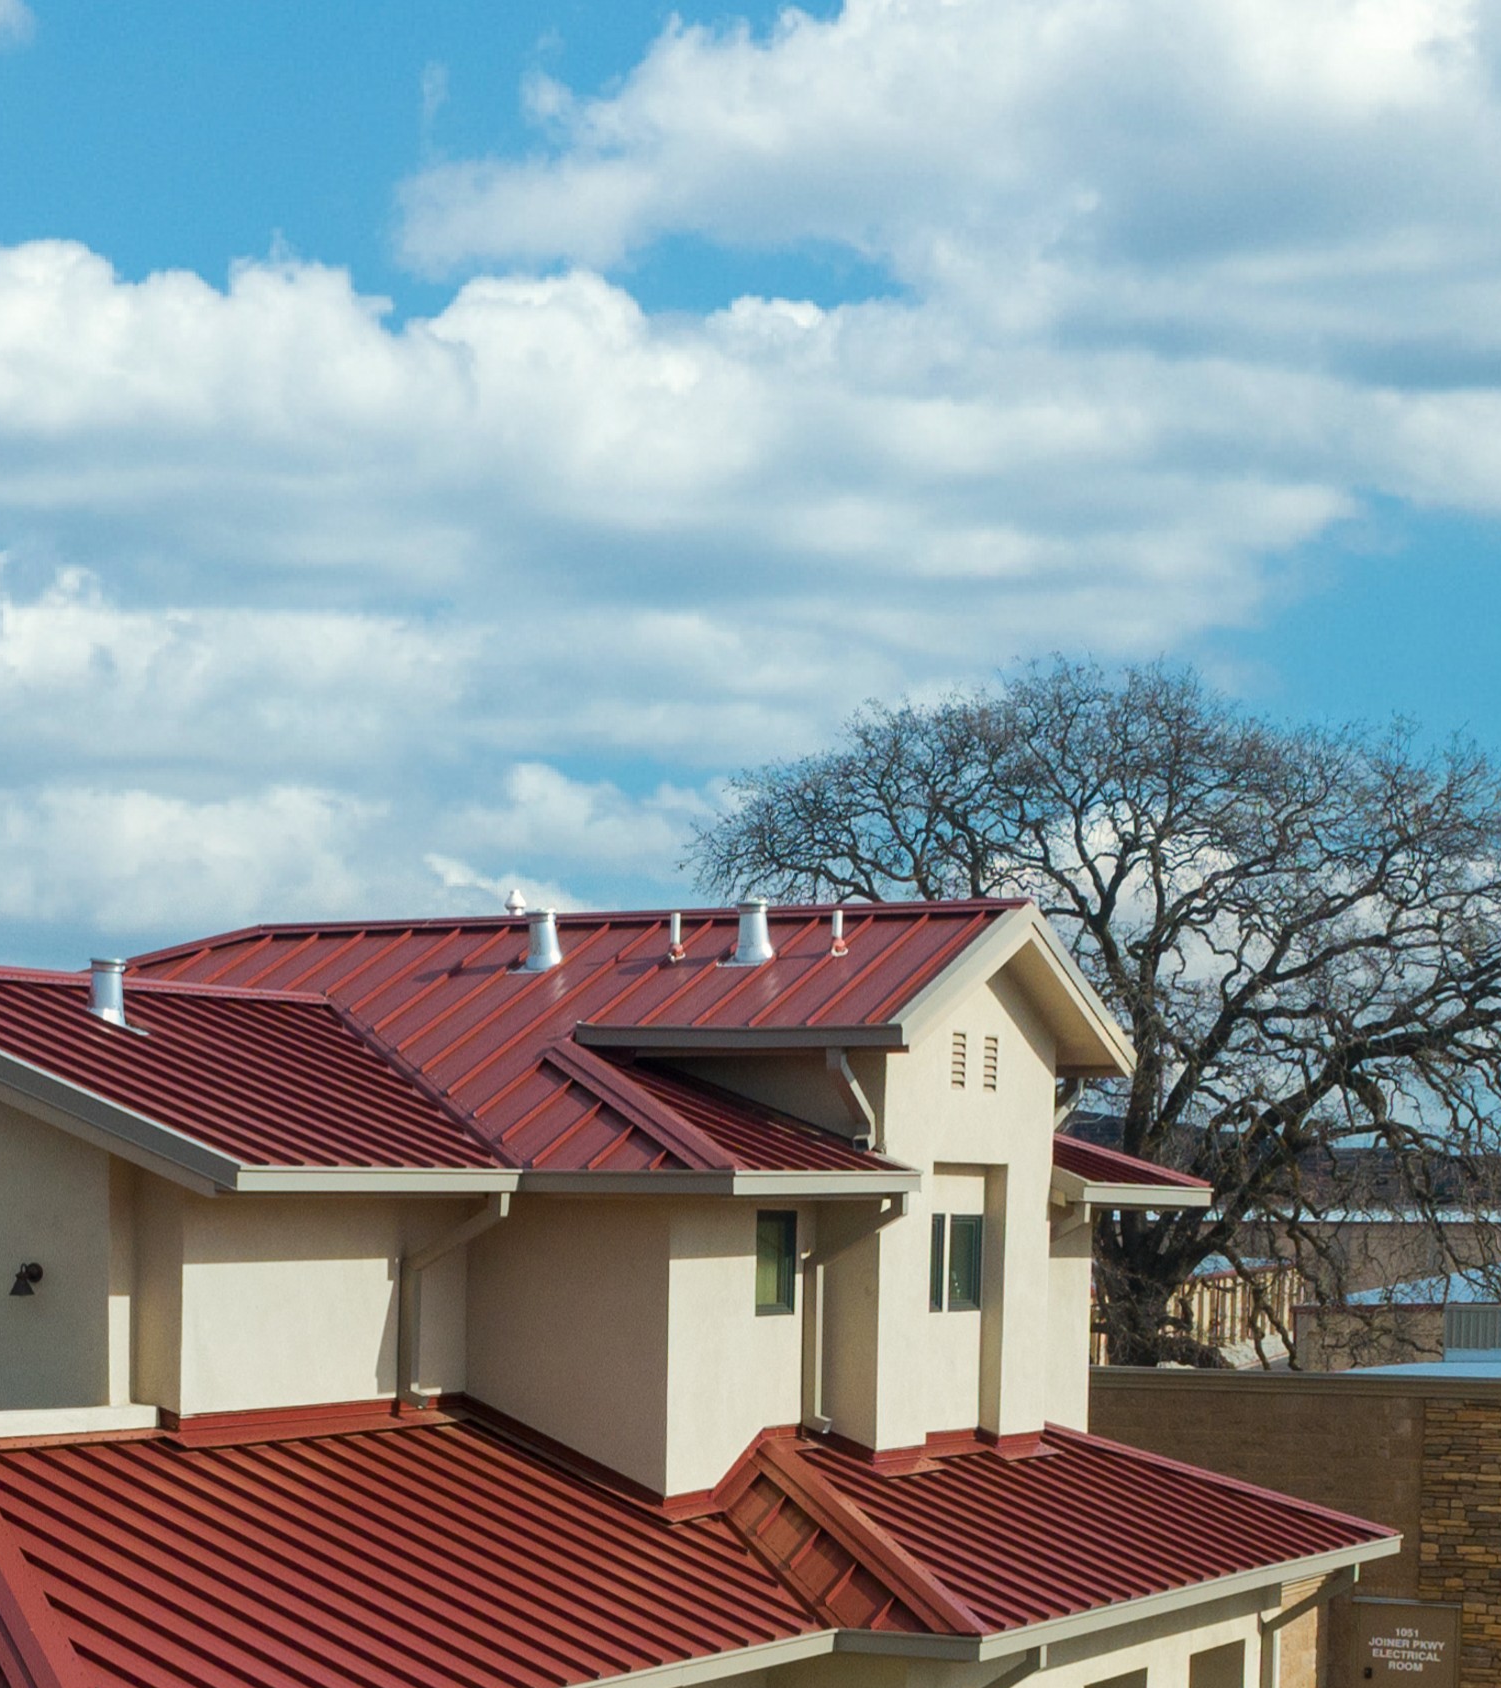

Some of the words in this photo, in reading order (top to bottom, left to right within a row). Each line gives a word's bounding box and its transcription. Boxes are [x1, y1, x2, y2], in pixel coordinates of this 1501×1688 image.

[1395, 1627, 1419, 1638] 1051
[1368, 1637, 1410, 1649] JOINER
[1412, 1639, 1445, 1651] PKWY
[1372, 1648, 1441, 1663] ELECTRICAL
[1388, 1660, 1423, 1672] ROOM
